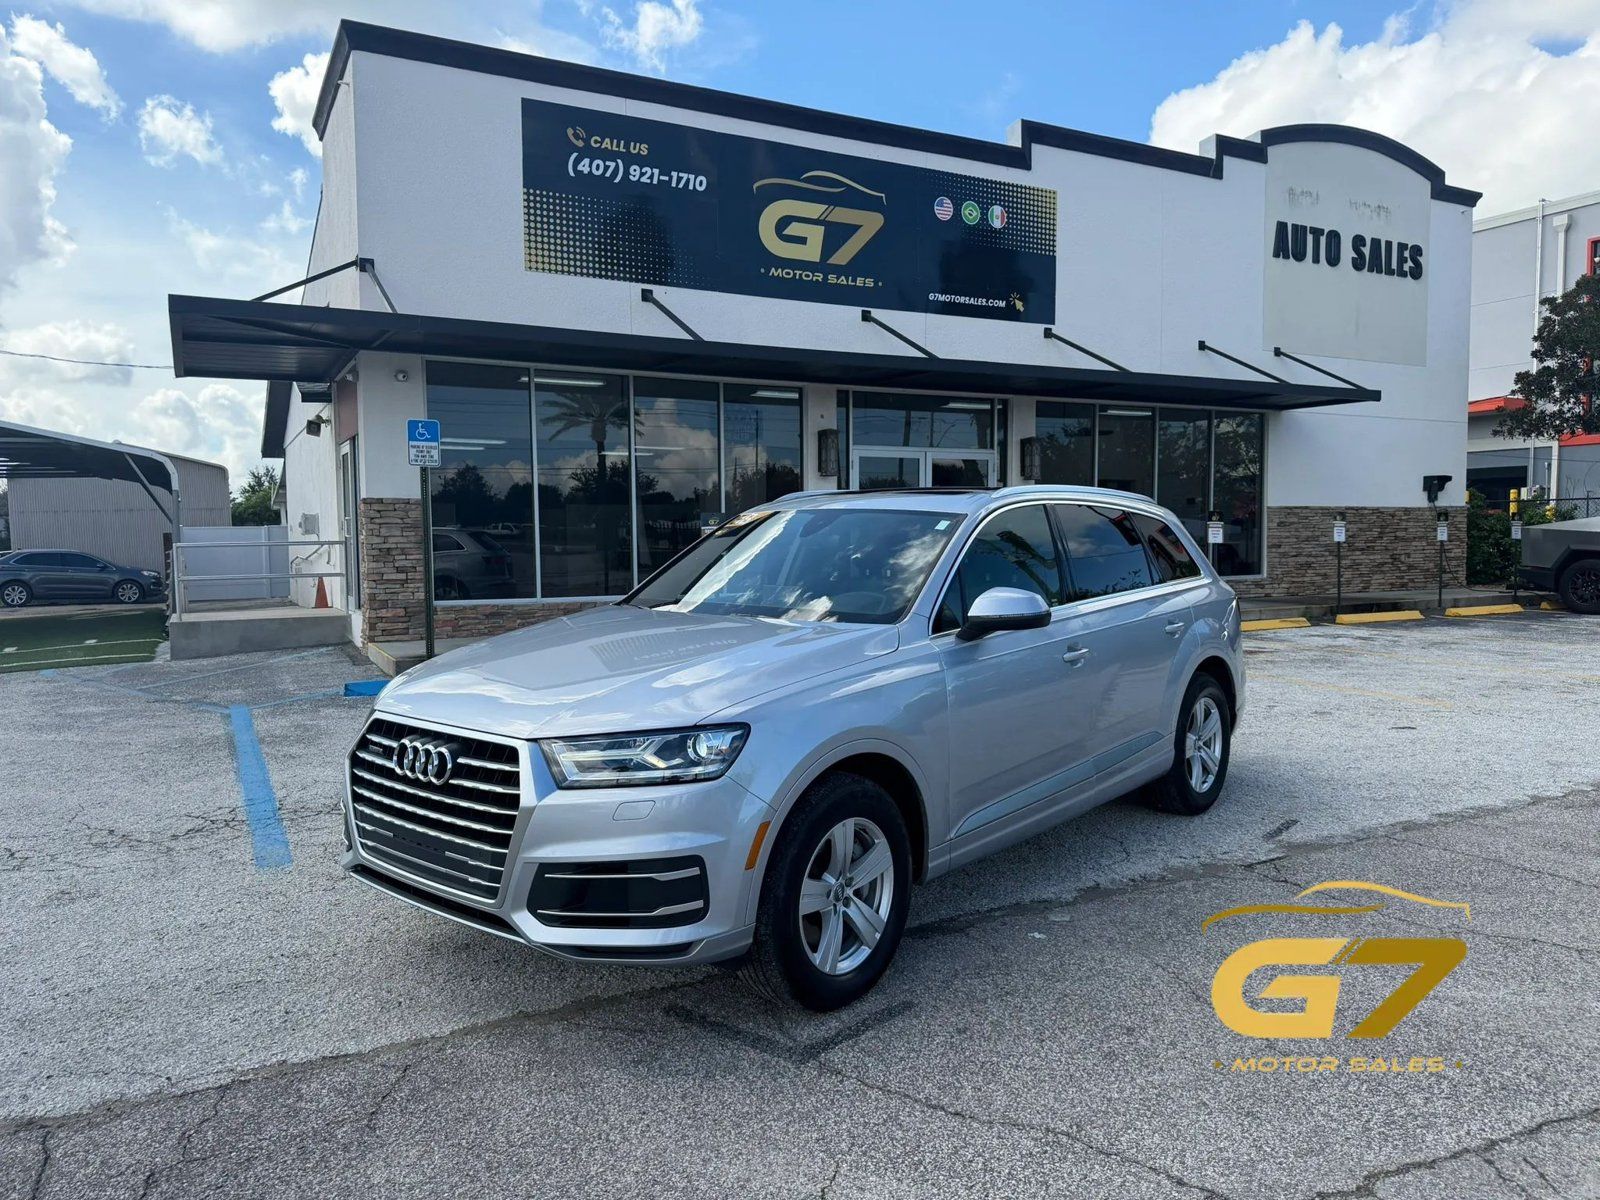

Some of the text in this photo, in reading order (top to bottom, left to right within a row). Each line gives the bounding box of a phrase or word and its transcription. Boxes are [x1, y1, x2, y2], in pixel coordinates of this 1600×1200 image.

[590, 136, 649, 155] CALL US
[567, 152, 708, 192] (407) 921-1710
[758, 199, 885, 266] G7
[1272, 220, 1423, 280] AUTO SALES
[769, 267, 875, 288] MOTOR SALES
[928, 293, 1006, 308] G7MOTORSALES.COM
